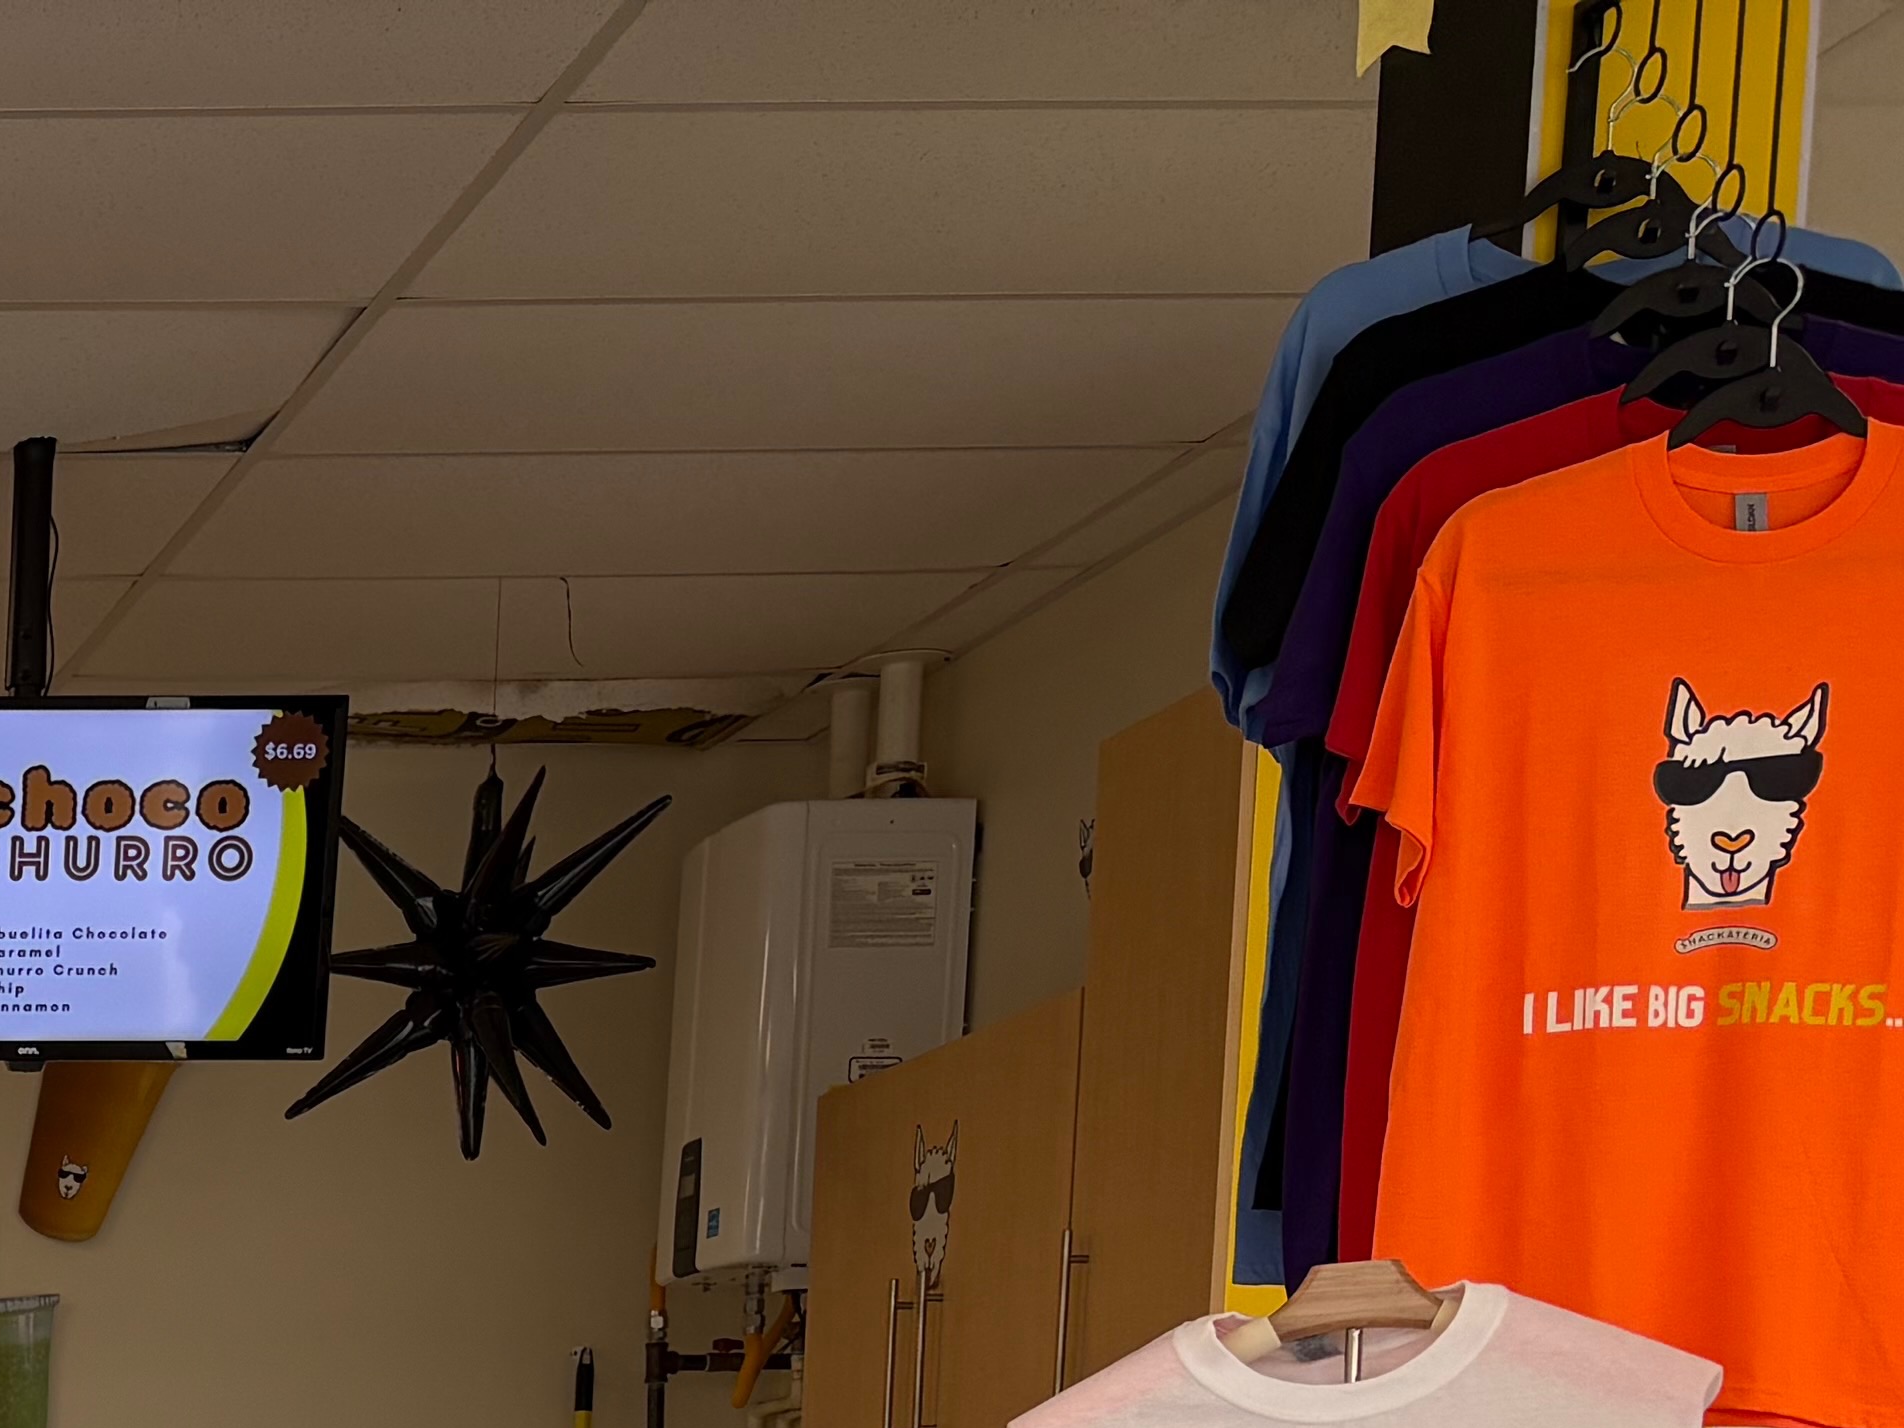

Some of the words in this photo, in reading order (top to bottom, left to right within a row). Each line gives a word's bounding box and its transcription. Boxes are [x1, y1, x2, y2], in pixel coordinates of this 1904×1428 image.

[264, 741, 317, 762] $6.69
[72, 926, 168, 941] Chocolate
[52, 963, 120, 978] Crunch
[1523, 994, 1535, 1034] I
[1546, 984, 1638, 1033] LIKE
[1648, 986, 1705, 1028] BIG
